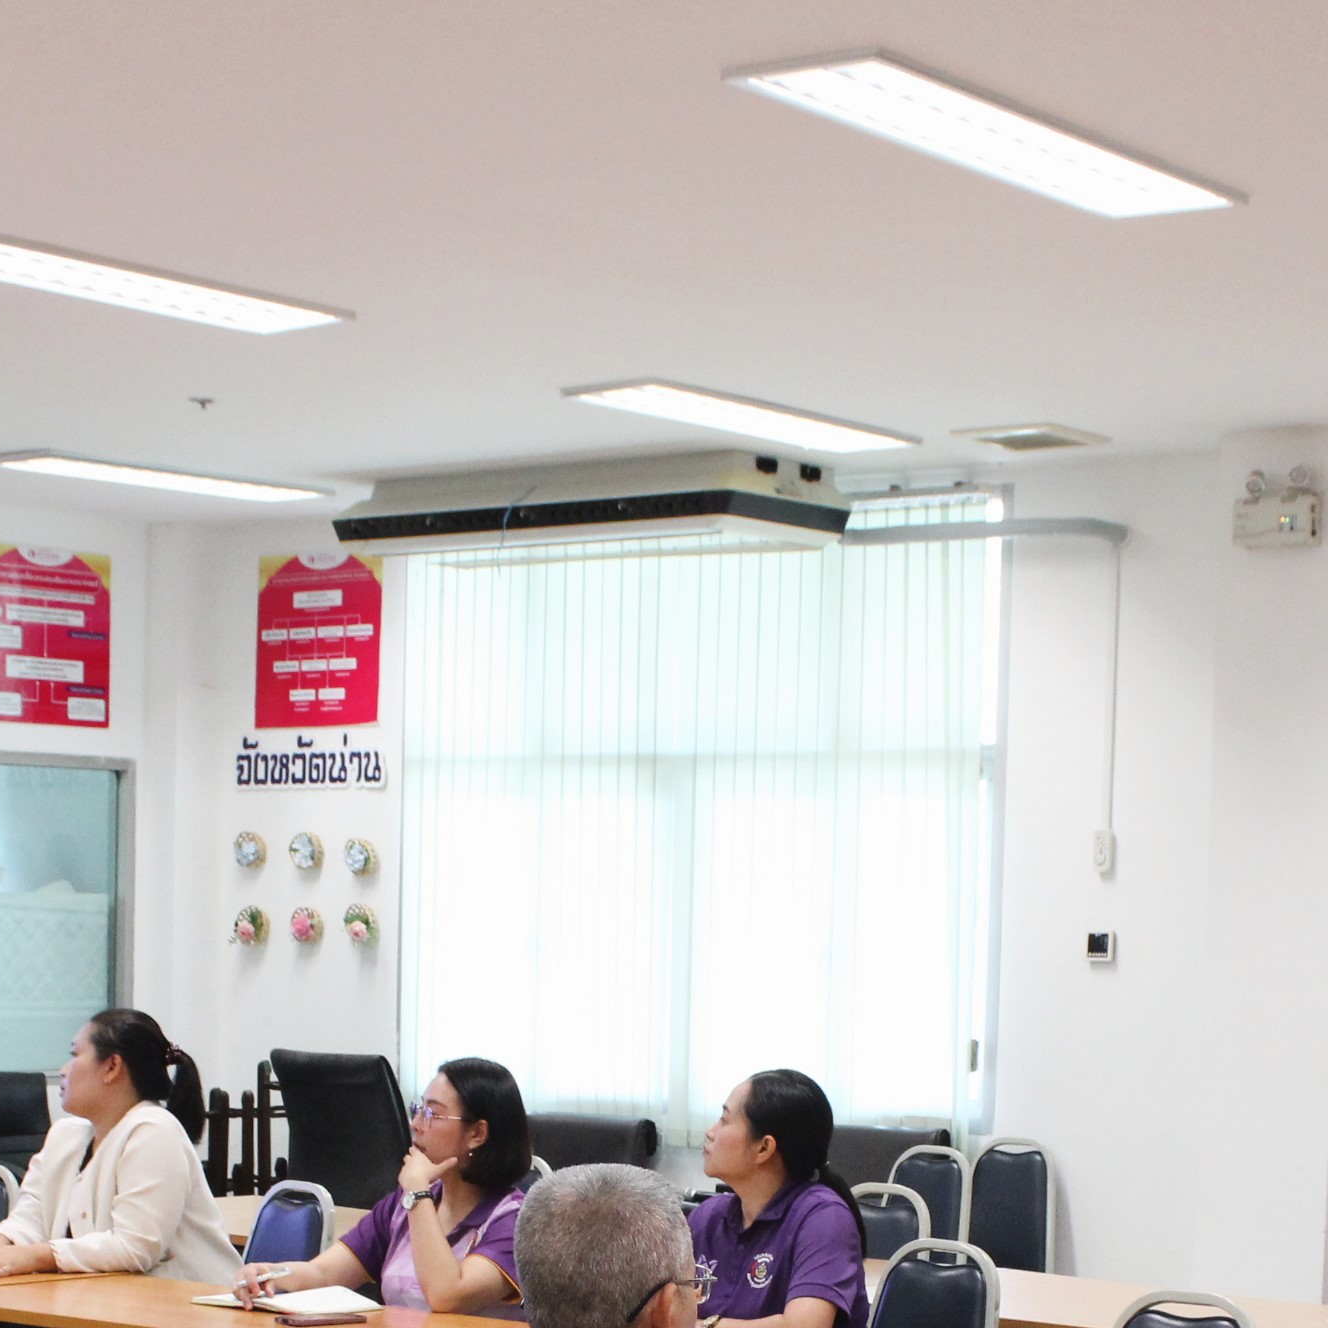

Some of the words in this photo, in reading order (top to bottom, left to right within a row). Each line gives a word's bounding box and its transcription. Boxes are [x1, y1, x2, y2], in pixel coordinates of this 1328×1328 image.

[236, 734, 383, 787] จังหวัดน่าน
